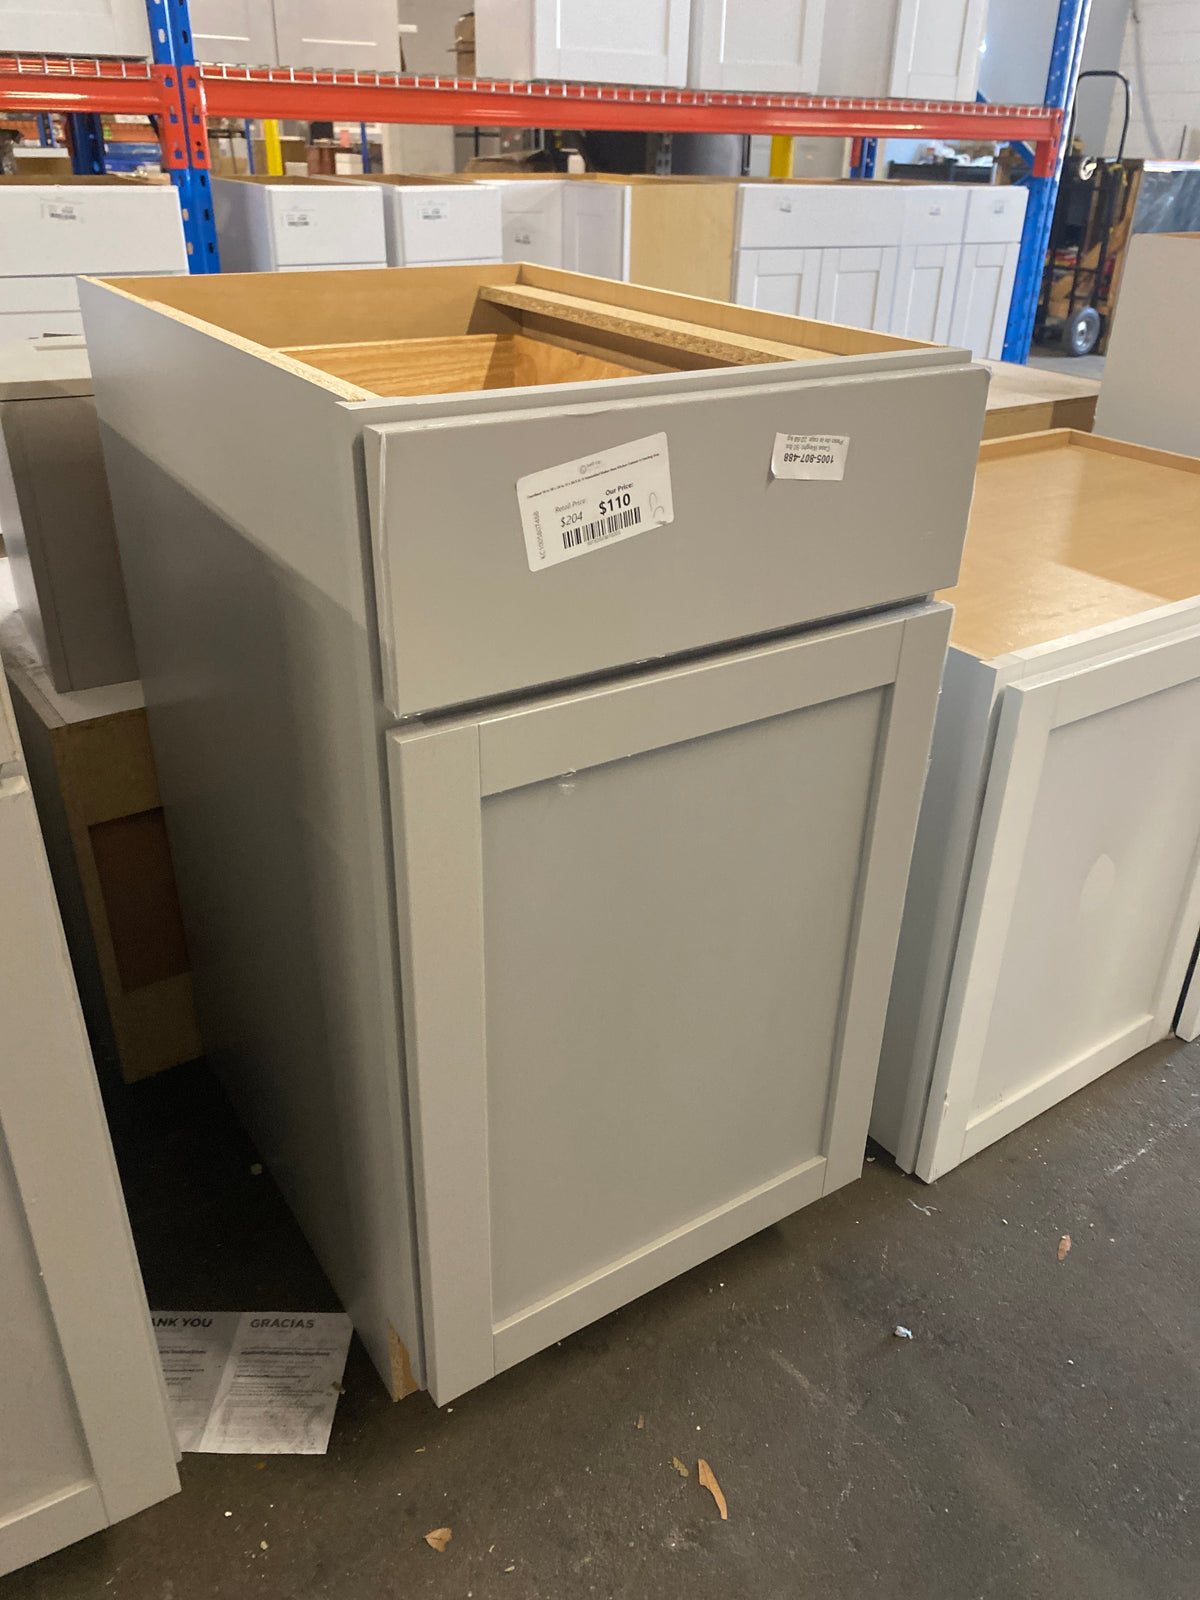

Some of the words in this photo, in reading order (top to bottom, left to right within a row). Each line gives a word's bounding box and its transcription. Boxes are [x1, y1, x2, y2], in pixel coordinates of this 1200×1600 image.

[783, 452, 834, 464] 1005-807-488
[605, 488, 616, 496] Our
[617, 481, 634, 491] Price:
[555, 502, 571, 513] Retail
[598, 493, 631, 516] $110
[560, 511, 583, 528] $204
[182, 1317, 214, 1328] YOU
[250, 1317, 316, 1329] GRACIAS
